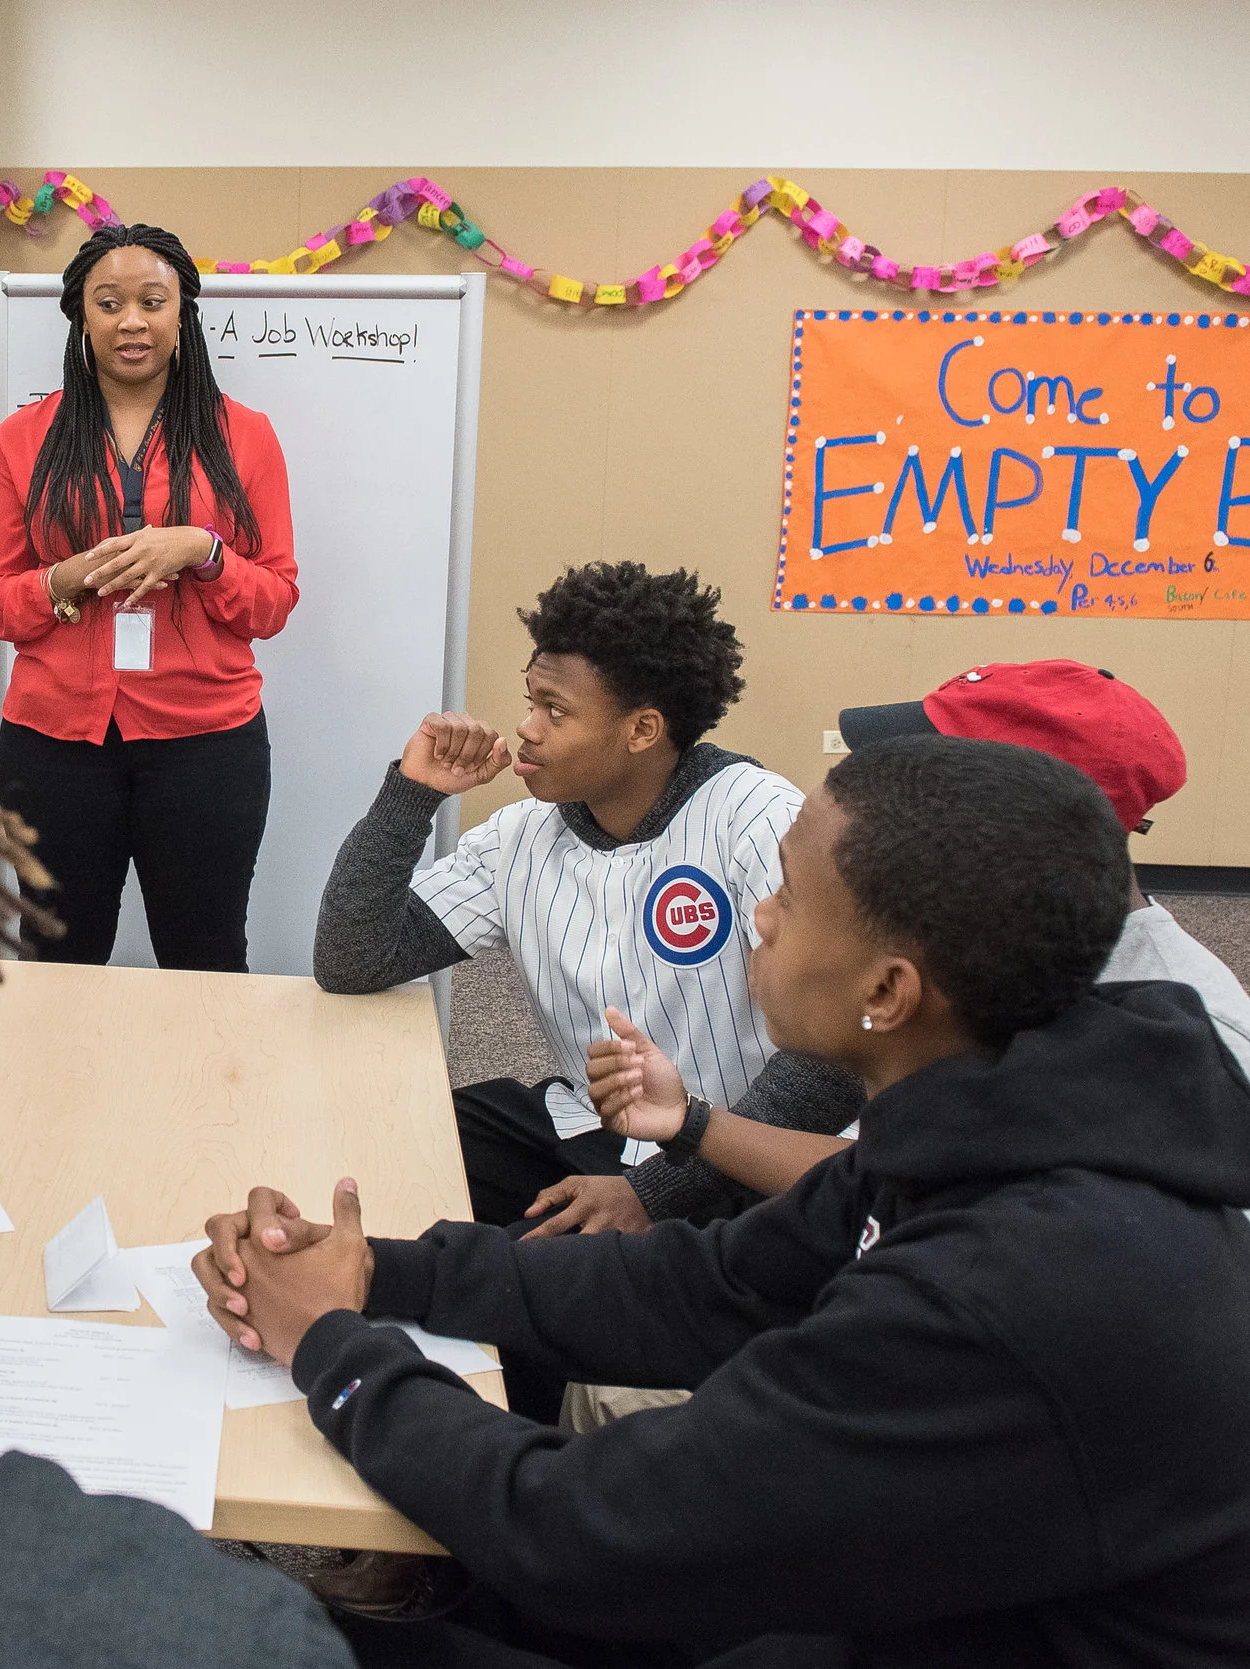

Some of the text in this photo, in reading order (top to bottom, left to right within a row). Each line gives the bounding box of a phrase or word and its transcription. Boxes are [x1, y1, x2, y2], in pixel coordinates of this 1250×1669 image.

[252, 311, 297, 343] Job
[939, 336, 1221, 430] Come to
[809, 432, 1188, 560] EMPTY
[1090, 552, 1196, 577] December
